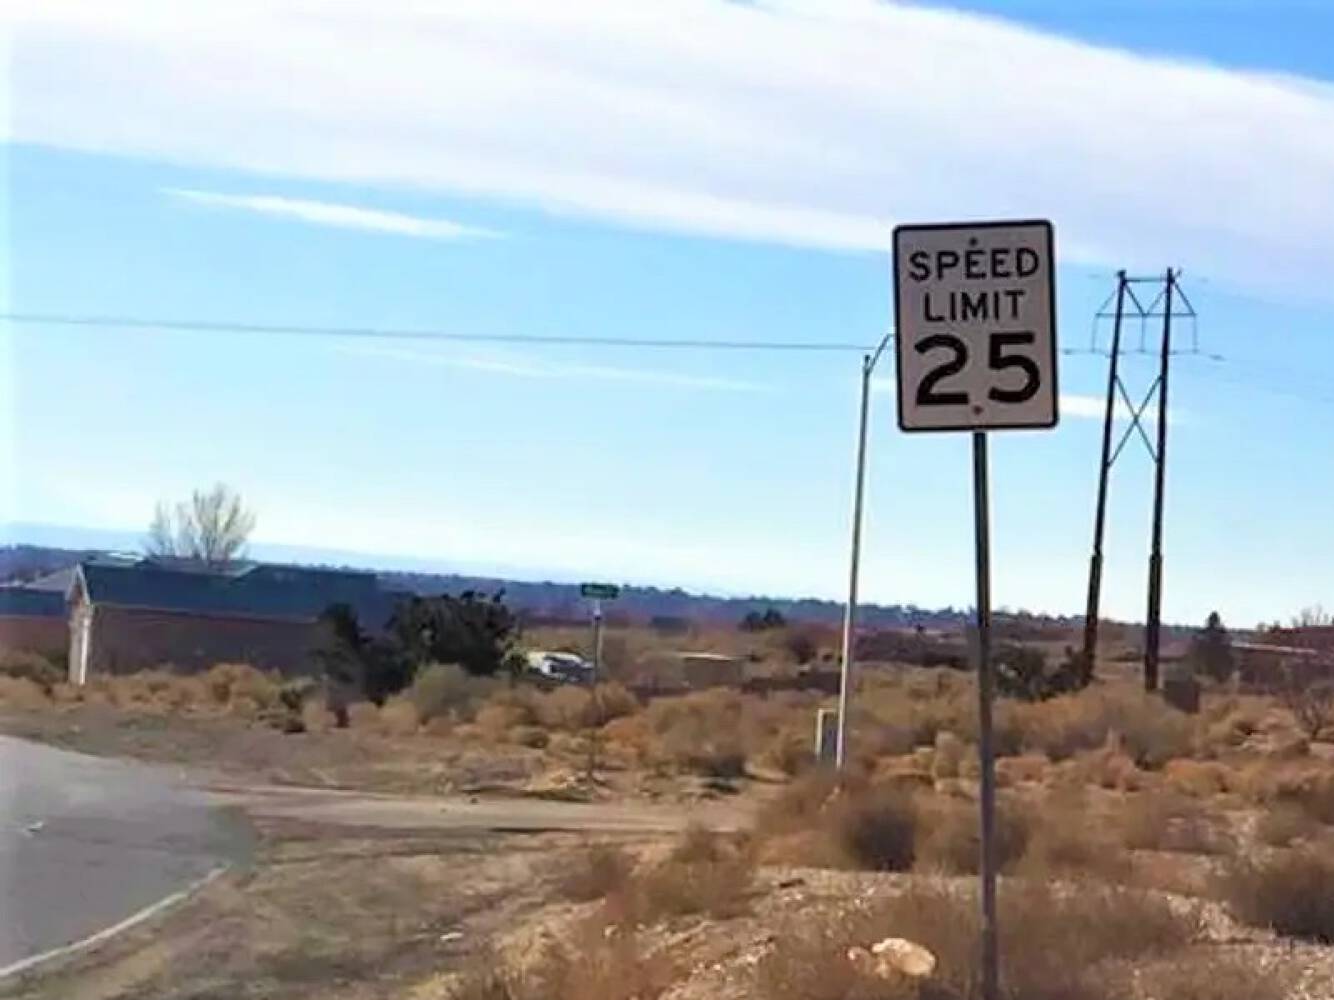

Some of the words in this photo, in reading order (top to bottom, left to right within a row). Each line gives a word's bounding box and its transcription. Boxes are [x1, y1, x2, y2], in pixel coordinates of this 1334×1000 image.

[909, 247, 1040, 281] SPEED
[924, 290, 1025, 322] LIMIT
[914, 332, 1041, 406] 25
